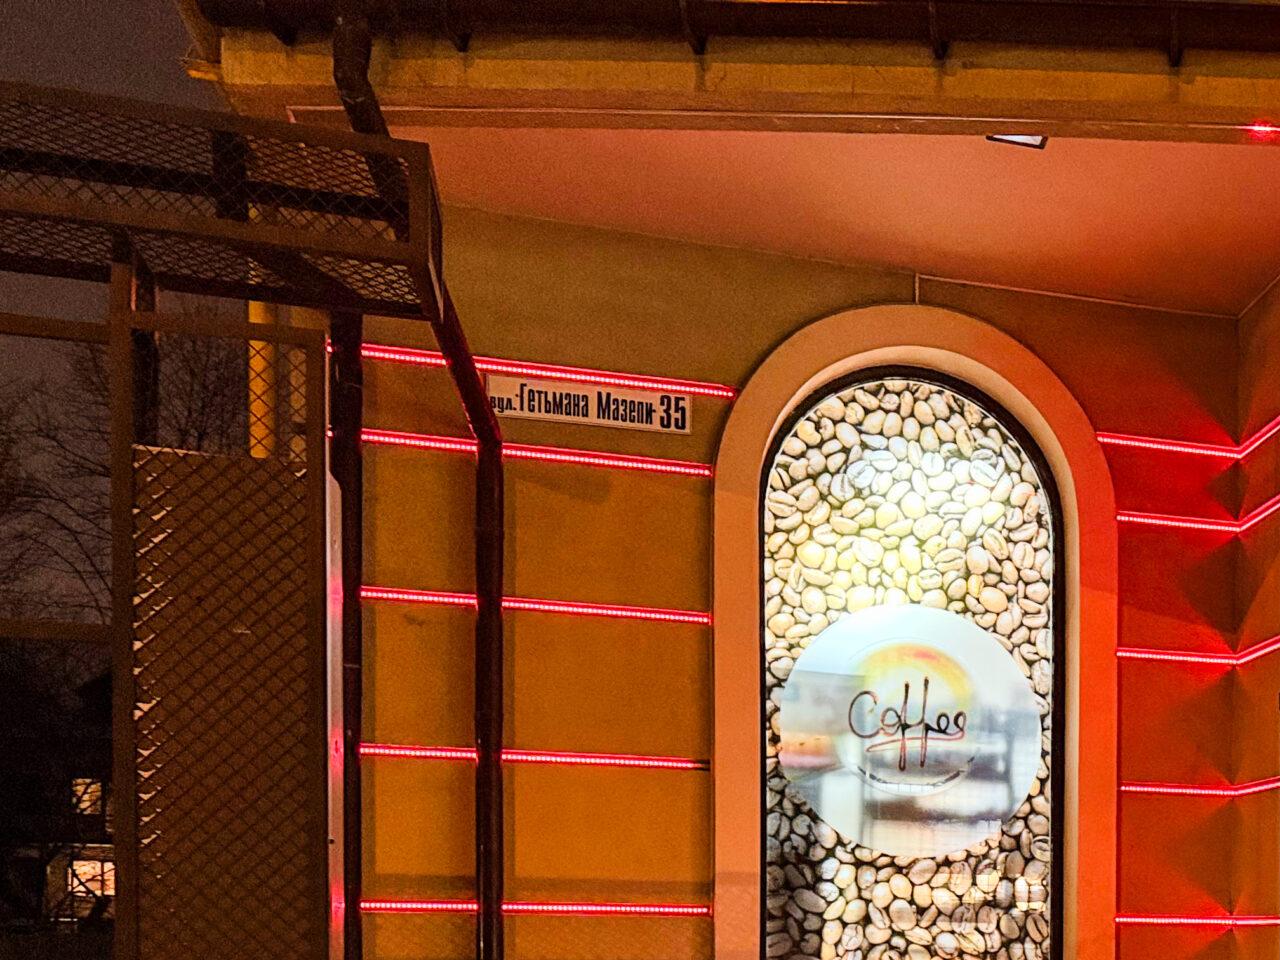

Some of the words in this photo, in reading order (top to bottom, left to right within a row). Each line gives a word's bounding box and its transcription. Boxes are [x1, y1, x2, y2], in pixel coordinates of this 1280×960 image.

[519, 383, 589, 418] Гетьмана
[597, 391, 654, 425] Мазепи
[659, 394, 687, 431] 35
[849, 676, 967, 772] Coffee
